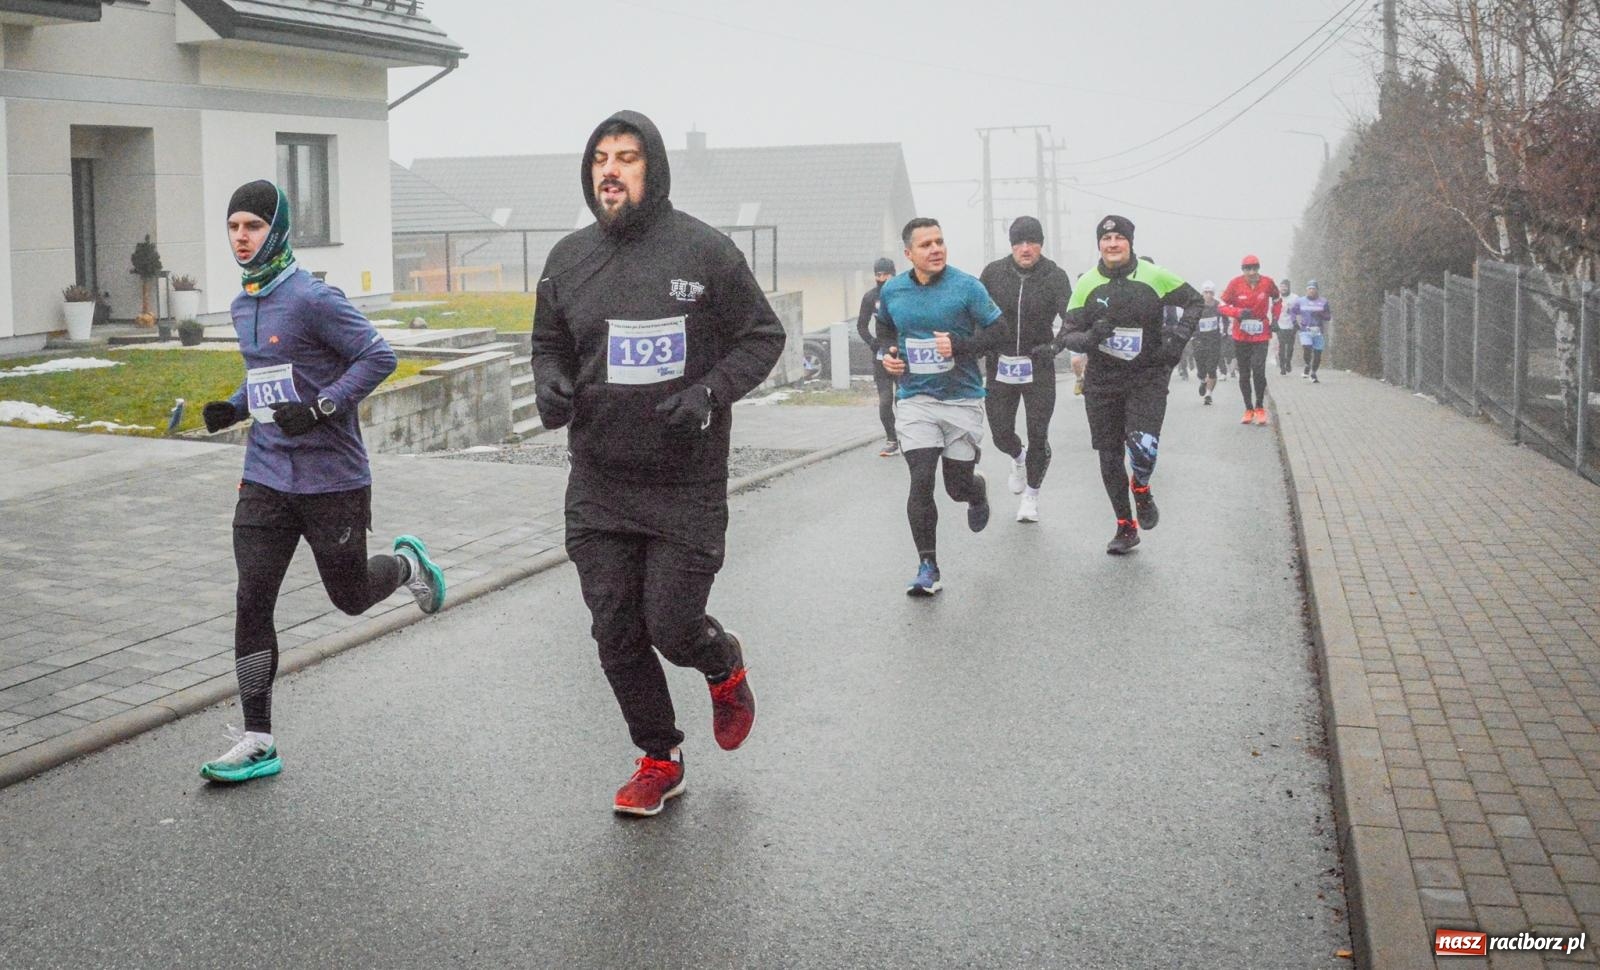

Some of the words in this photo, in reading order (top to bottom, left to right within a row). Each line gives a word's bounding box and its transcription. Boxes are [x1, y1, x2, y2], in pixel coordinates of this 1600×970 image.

[620, 336, 672, 365] 193
[1006, 363, 1022, 376] 14
[254, 381, 289, 407] 181
